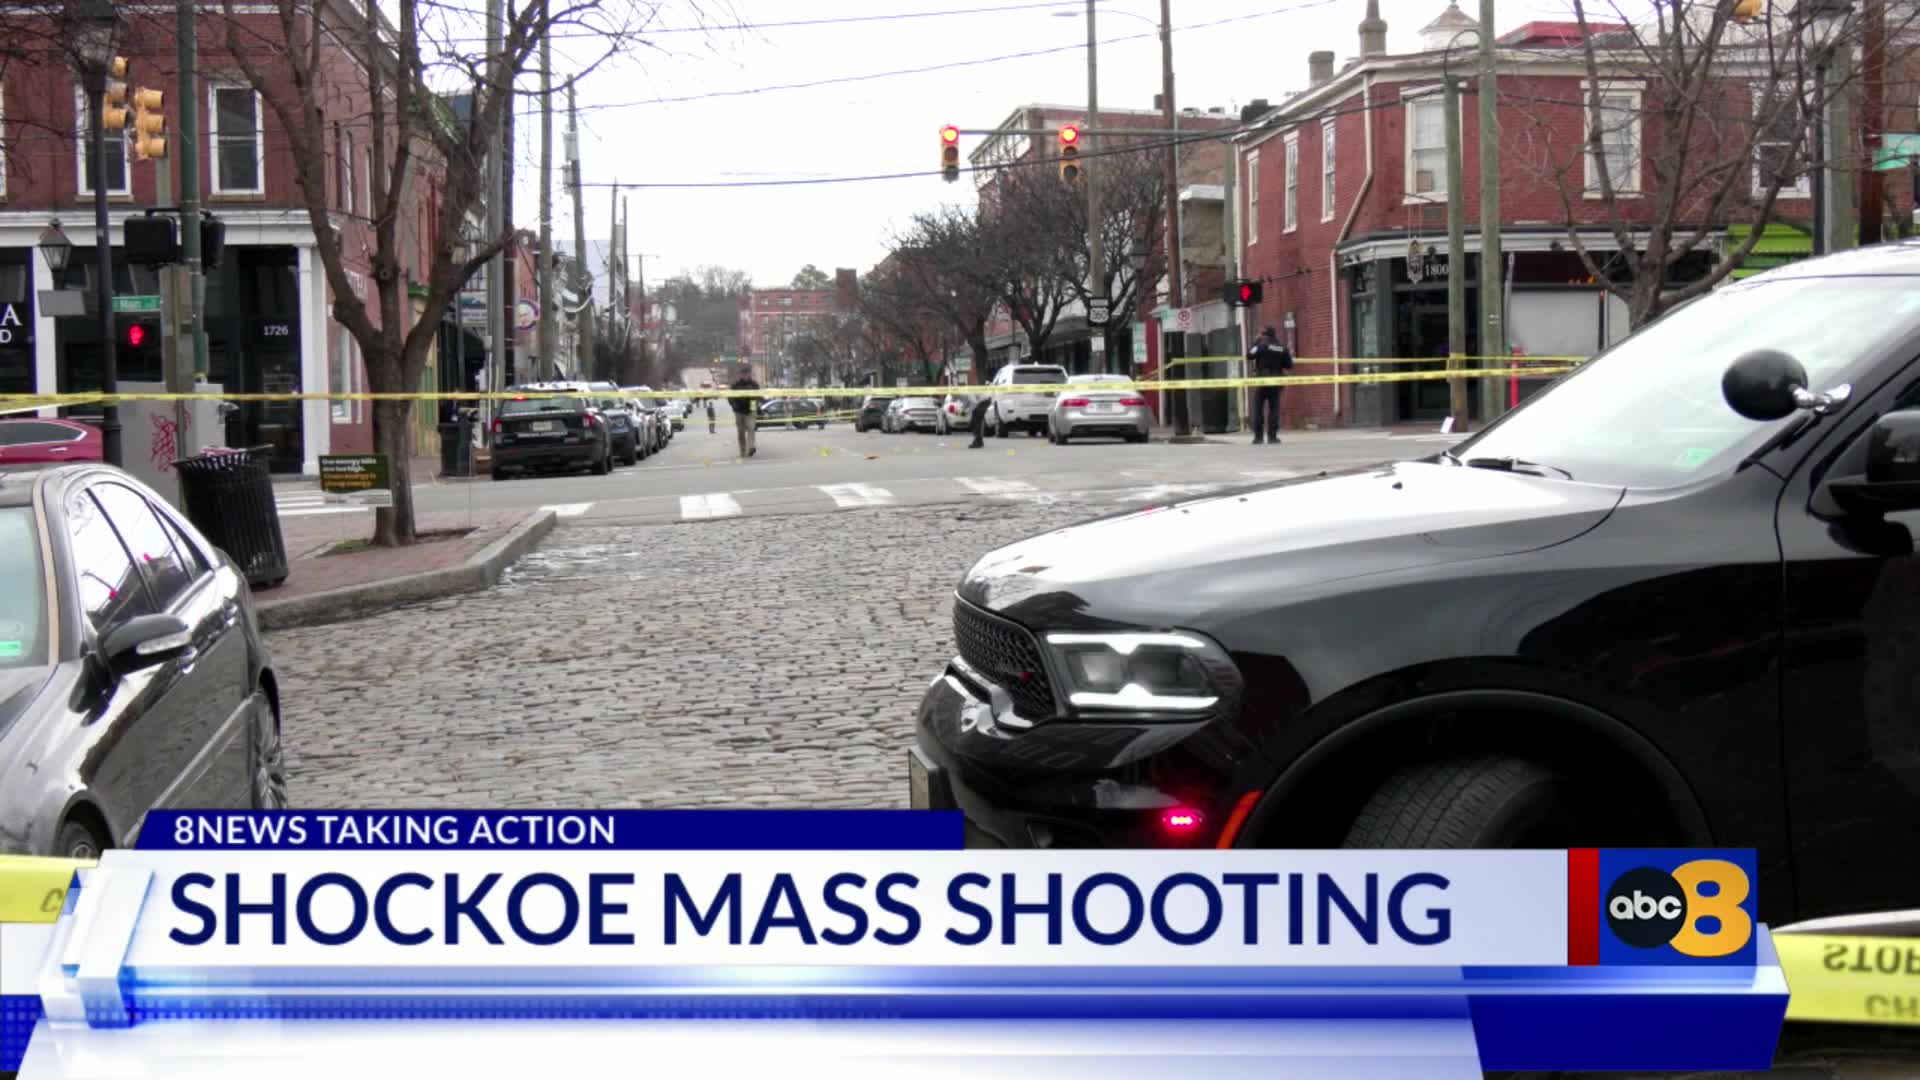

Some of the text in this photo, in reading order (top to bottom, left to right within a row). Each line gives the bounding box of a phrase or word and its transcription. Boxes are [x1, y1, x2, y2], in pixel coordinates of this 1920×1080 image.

[1426, 263, 1449, 277] 1800
[0, 303, 23, 327] A
[263, 325, 289, 336] 1726
